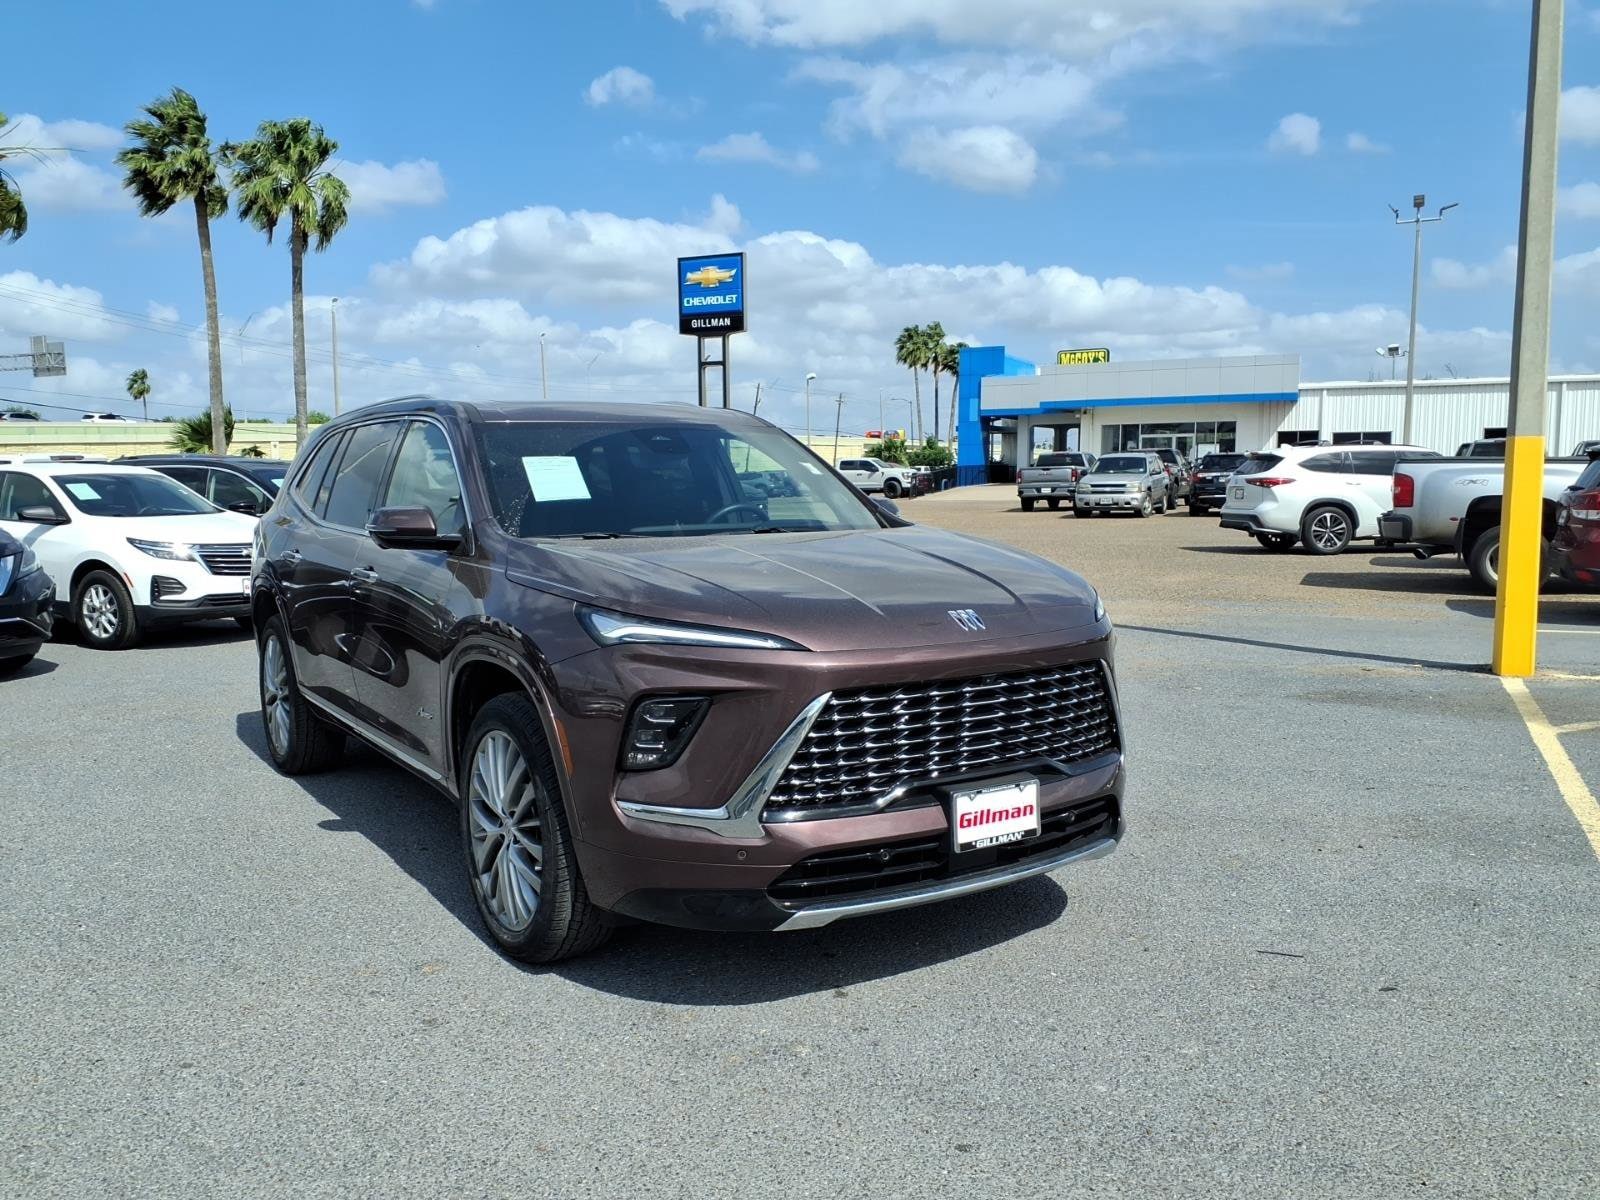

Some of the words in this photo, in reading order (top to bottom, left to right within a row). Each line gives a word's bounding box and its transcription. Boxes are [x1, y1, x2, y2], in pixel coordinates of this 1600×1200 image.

[683, 294, 738, 307] CHEVROLET
[691, 317, 731, 328] GILLMAN
[959, 804, 1034, 829] Gillman
[976, 832, 1023, 848] GILLMAN
